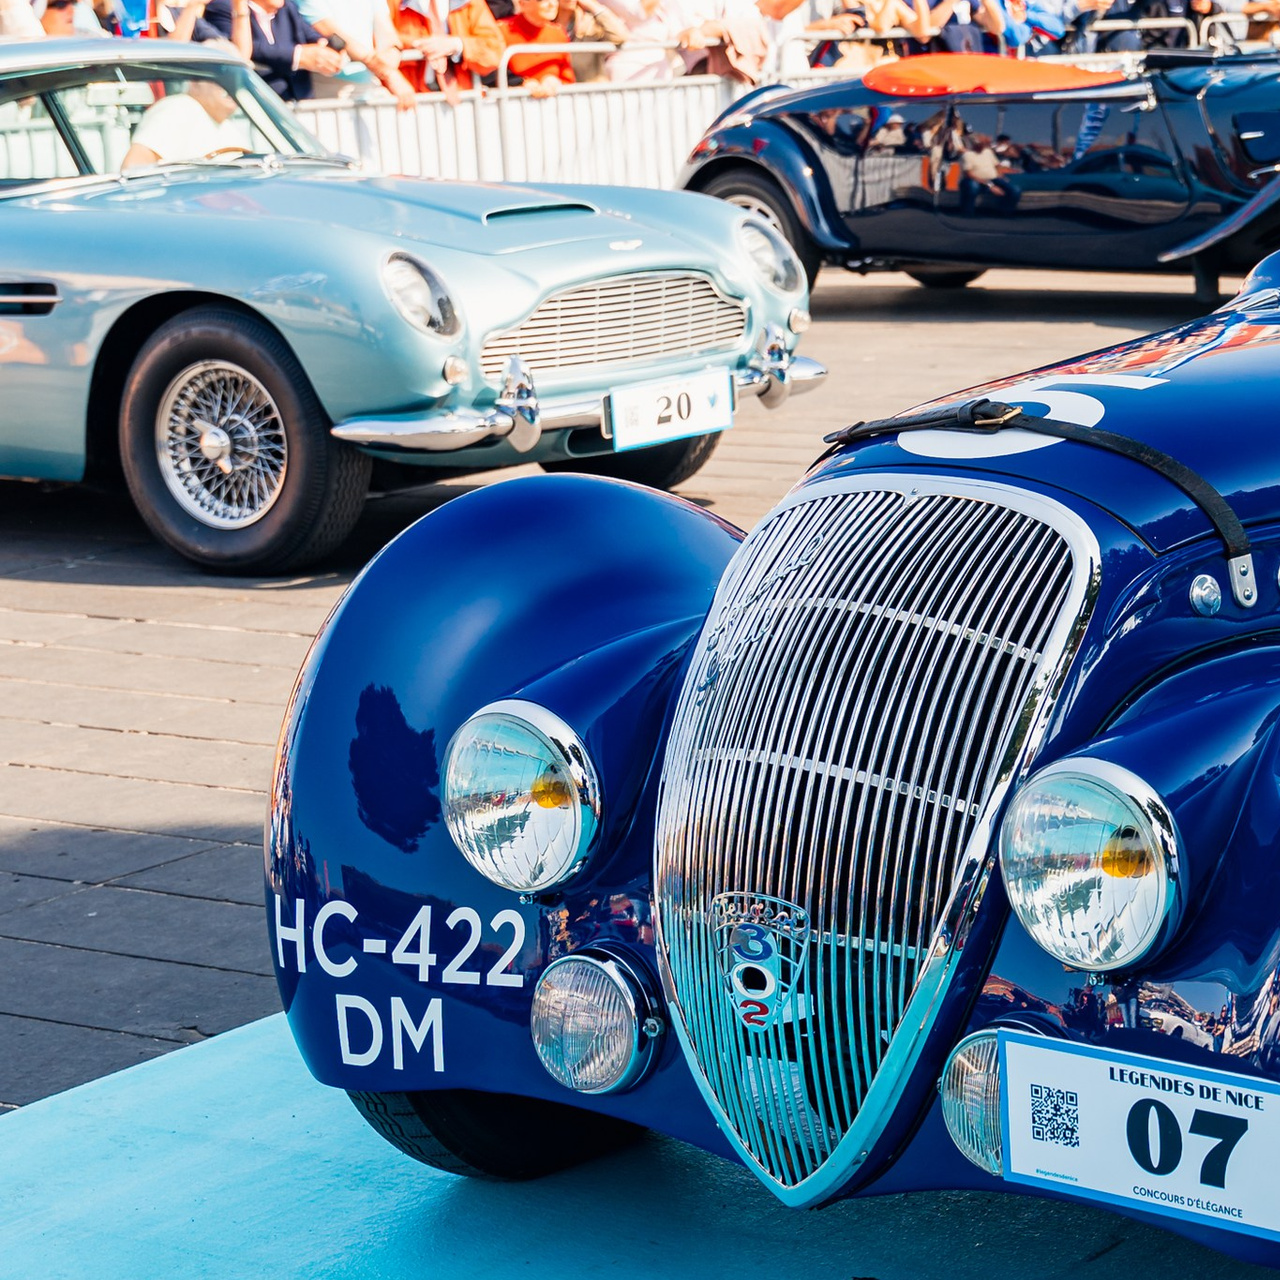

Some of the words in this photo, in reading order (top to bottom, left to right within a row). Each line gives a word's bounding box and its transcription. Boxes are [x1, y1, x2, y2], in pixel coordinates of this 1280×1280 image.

[656, 391, 692, 426] 20
[275, 894, 526, 987] HC-422
[335, 993, 445, 1072] DM
[1109, 1066, 1195, 1097] LEGENDES
[1199, 1084, 1222, 1103] DE
[1225, 1090, 1264, 1111] NICE
[1126, 1098, 1249, 1189] 07
[1132, 1185, 1185, 1206] CONCOURS
[1187, 1196, 1244, 1219] D'ÉLÉGANCE
